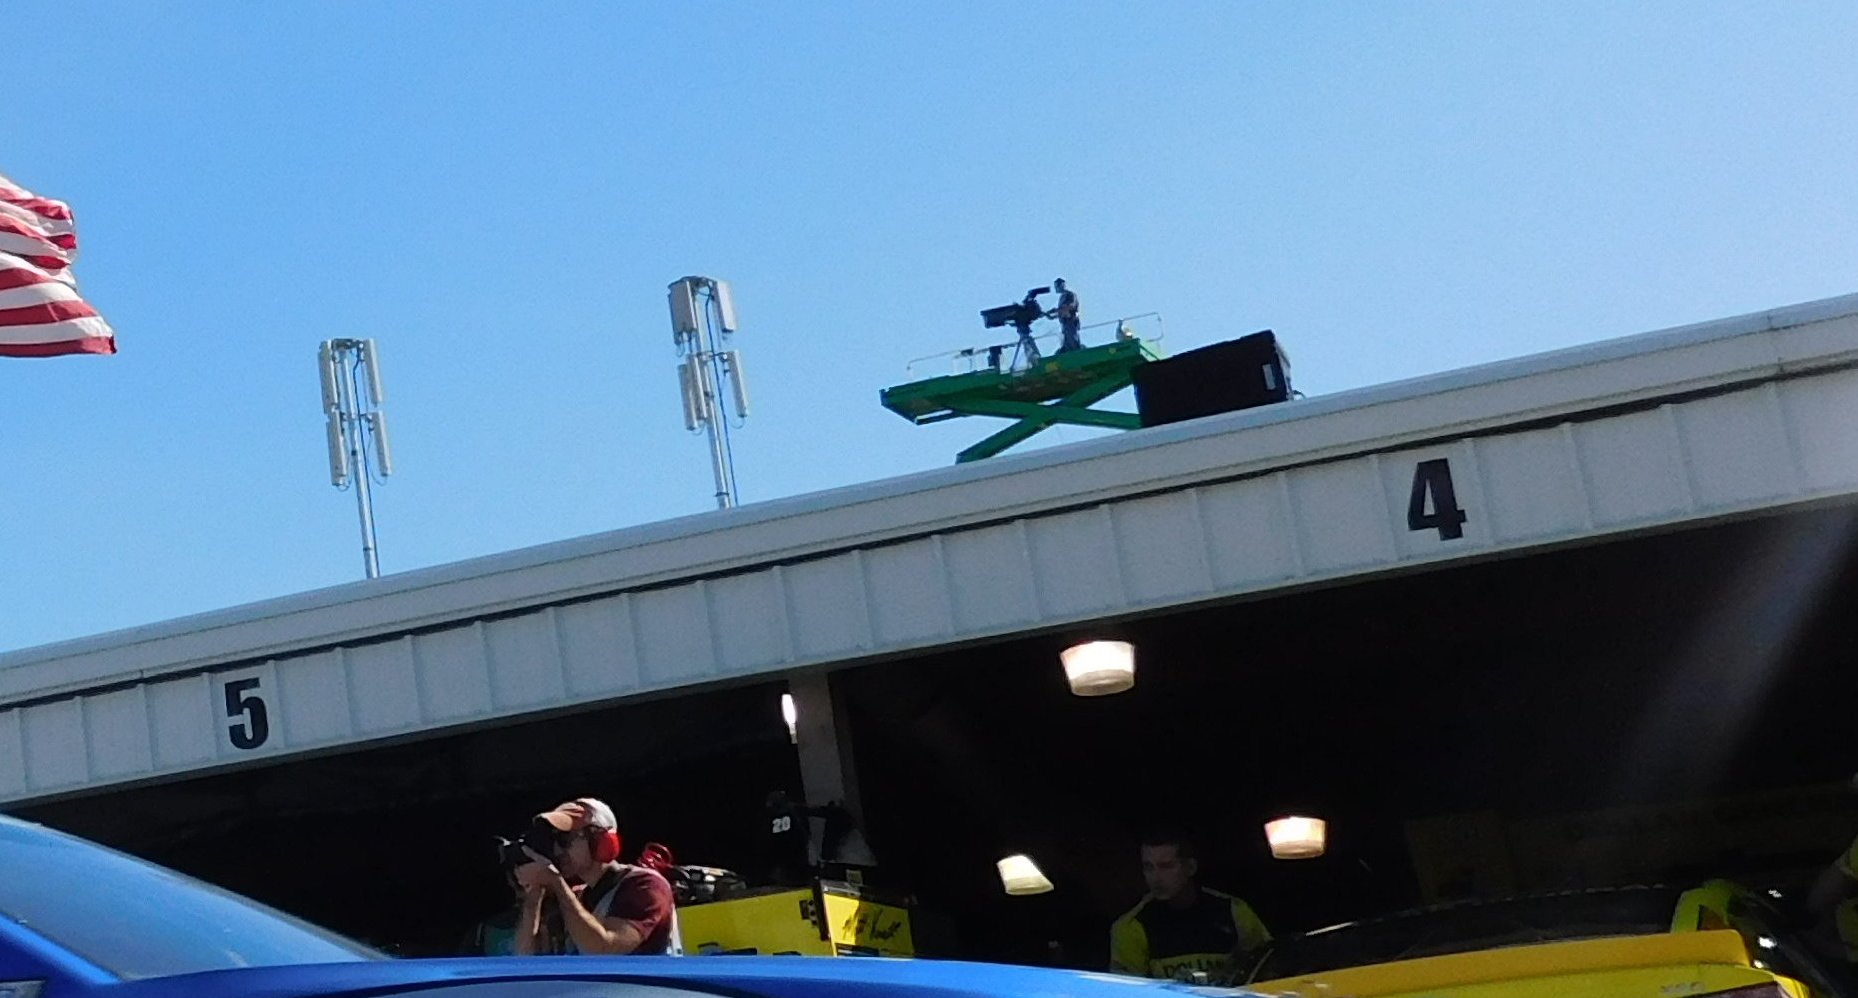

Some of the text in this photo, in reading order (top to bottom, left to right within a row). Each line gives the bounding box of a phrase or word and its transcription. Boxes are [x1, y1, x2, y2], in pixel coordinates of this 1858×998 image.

[1407, 458, 1468, 541] 4
[225, 679, 270, 752] 5
[771, 815, 791, 834] 20
